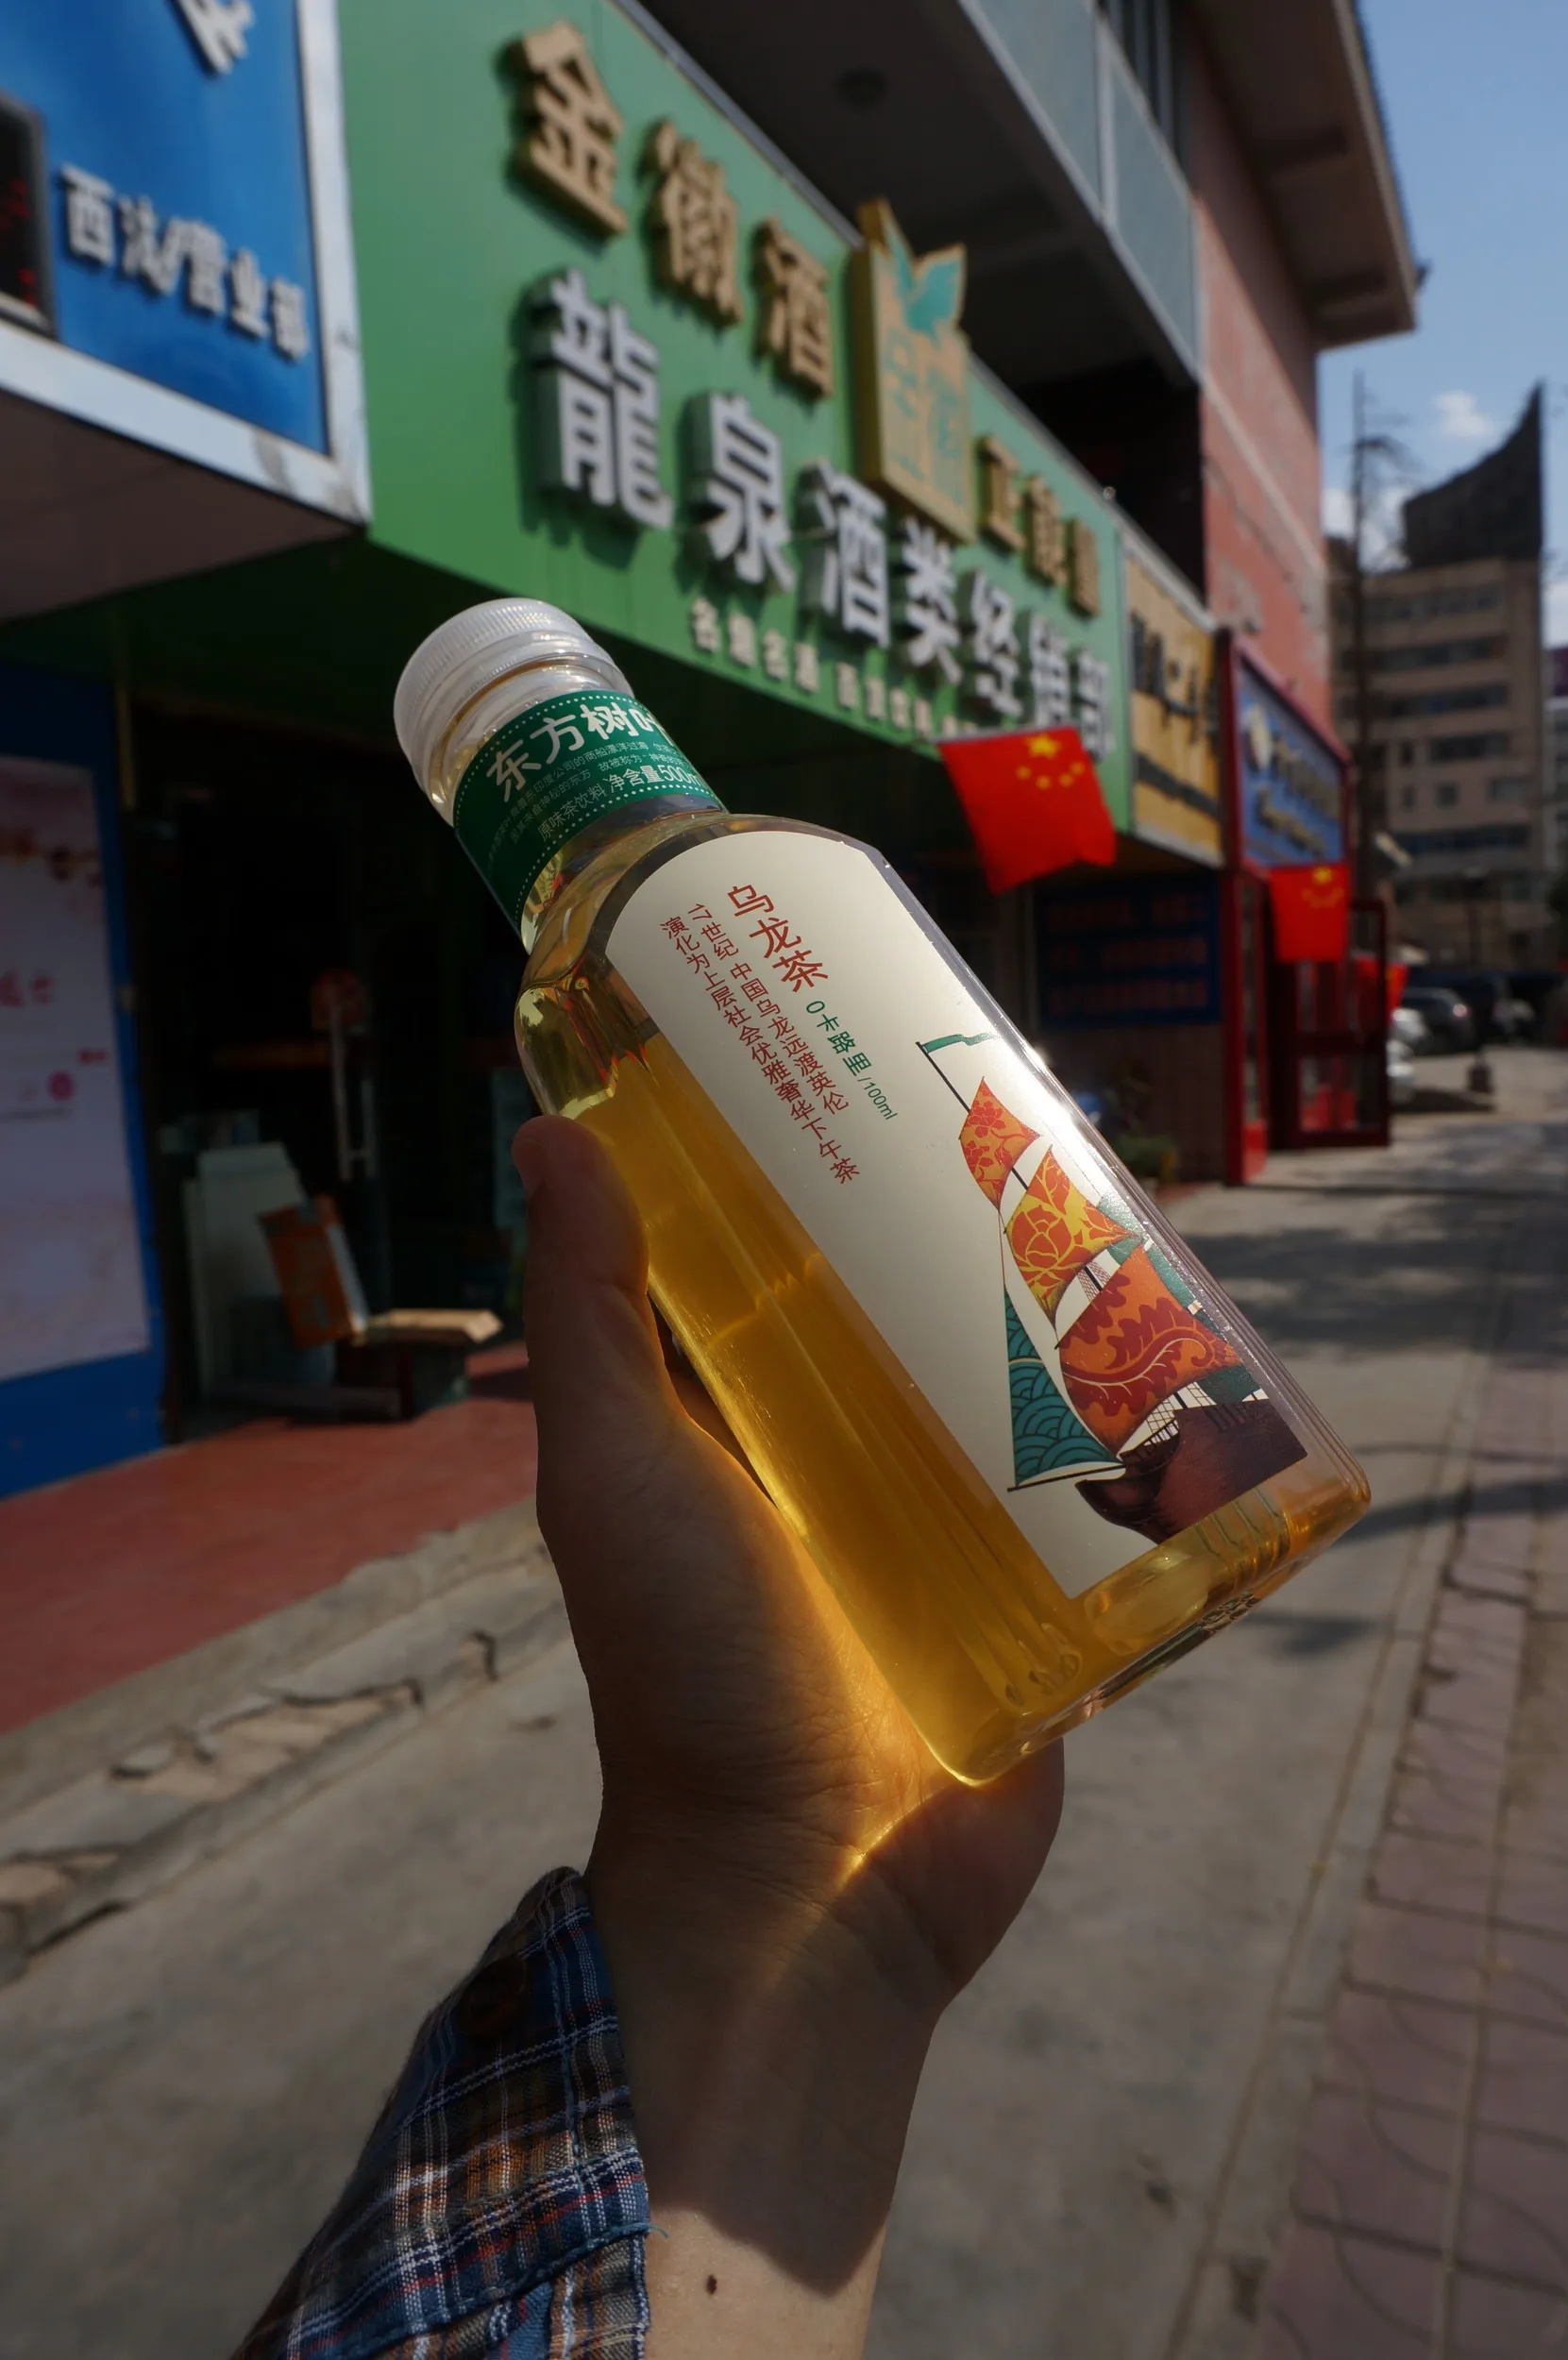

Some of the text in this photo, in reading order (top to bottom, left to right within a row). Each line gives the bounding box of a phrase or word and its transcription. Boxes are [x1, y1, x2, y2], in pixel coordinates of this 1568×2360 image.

[537, 783, 608, 842] 原味茶饮料
[727, 884, 829, 993] 乌龙茶
[659, 916, 860, 1184] 演化为上层社会优雅奢华下午茶
[805, 1000, 898, 1121] 0卡路里/100ml
